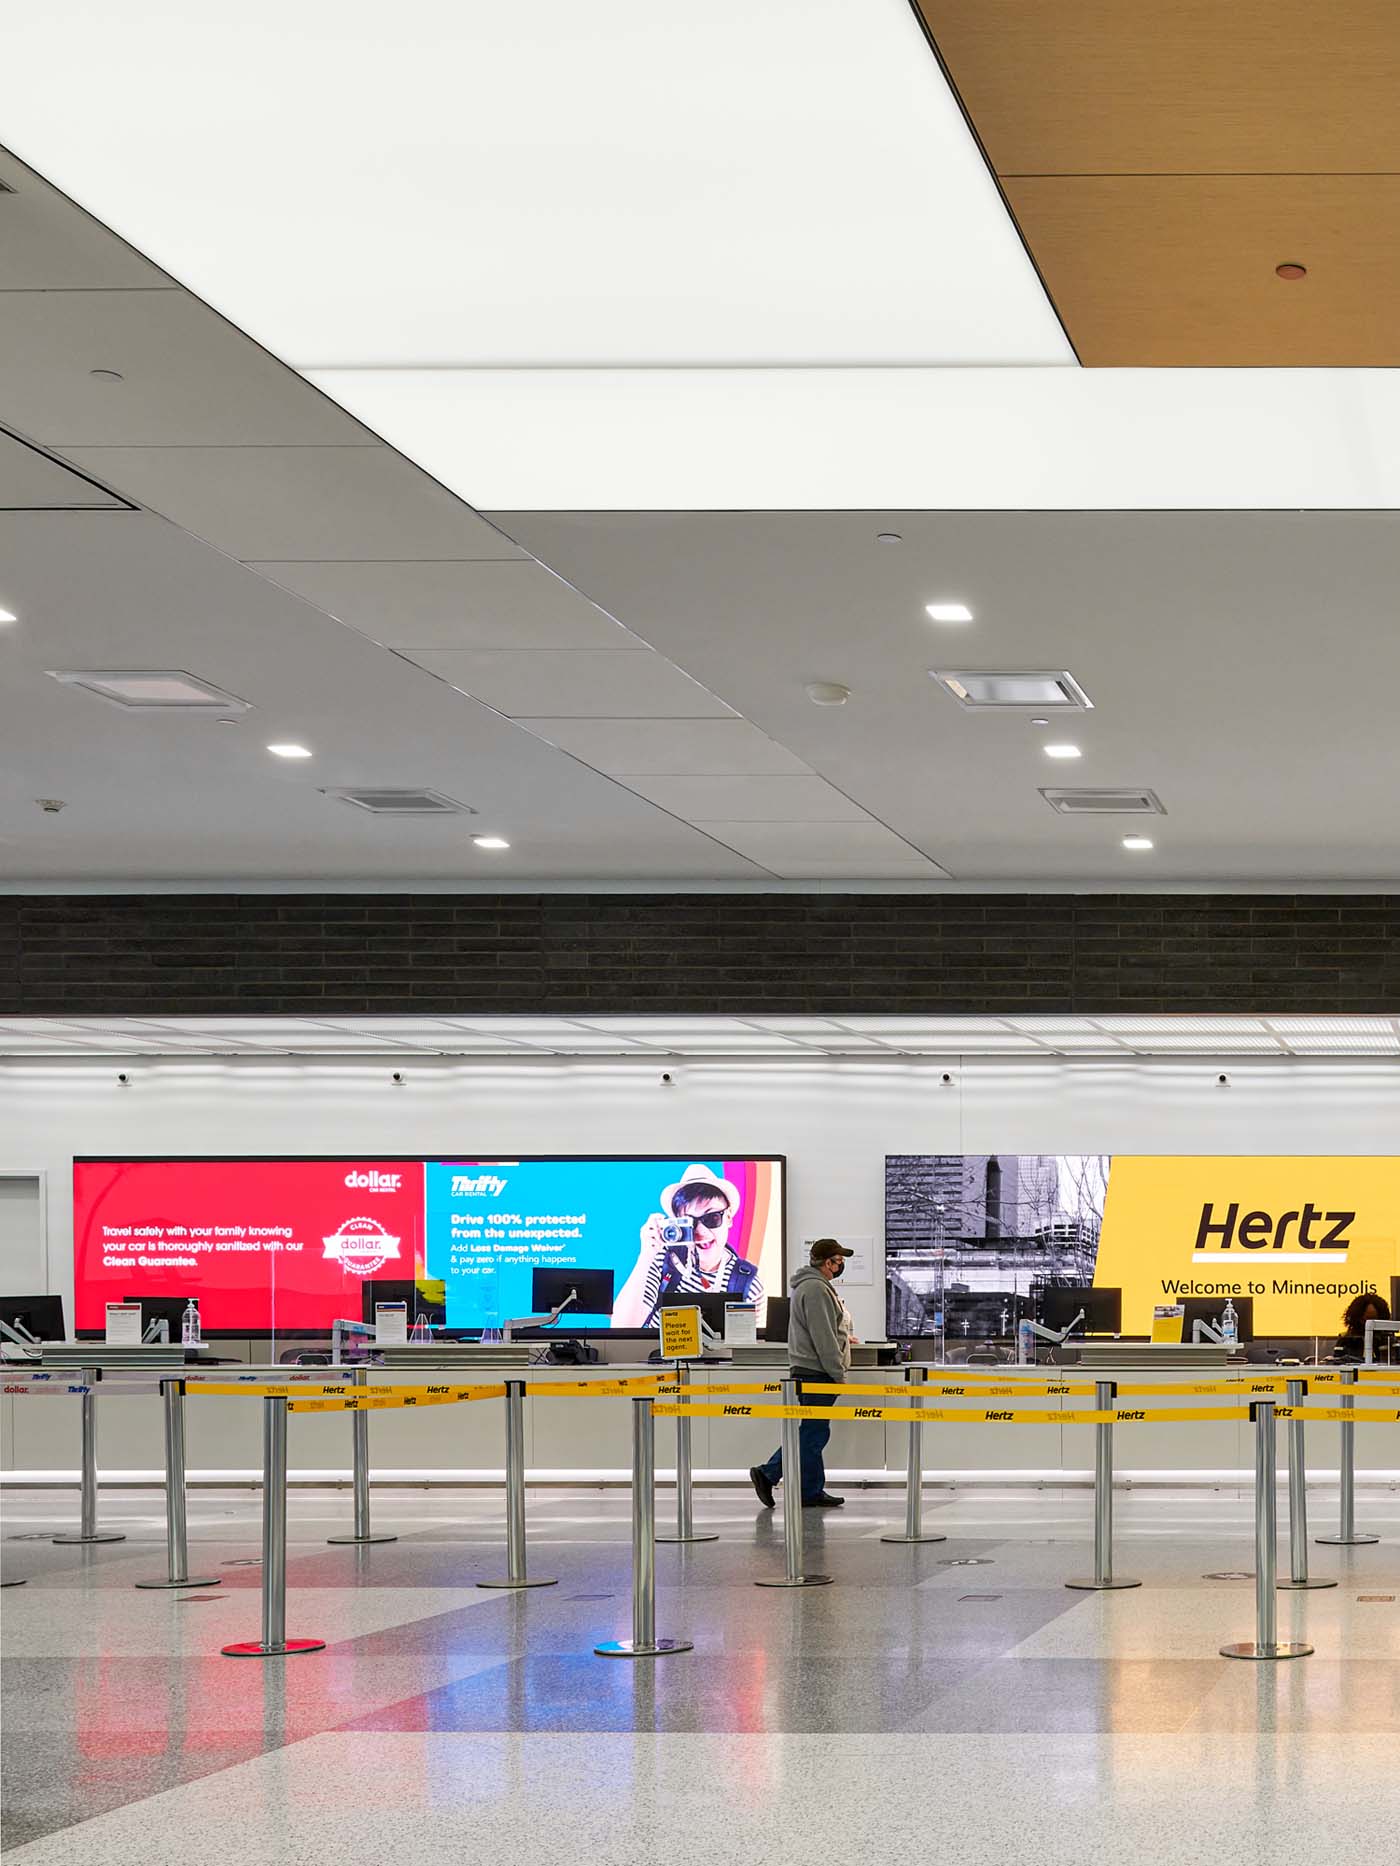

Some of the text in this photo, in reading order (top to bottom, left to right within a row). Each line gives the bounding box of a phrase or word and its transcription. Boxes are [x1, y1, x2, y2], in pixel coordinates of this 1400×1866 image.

[344, 1170, 402, 1188] dollar.
[451, 1175, 508, 1197] Thrifty
[451, 1213, 587, 1227] Drive 100% protected
[1195, 1203, 1356, 1250] Hertz
[102, 1226, 293, 1238] Travel safely with your family knowing
[451, 1227, 583, 1240] from the unexpected.
[102, 1241, 304, 1253] your car is thoroughly sanitized with our
[341, 1238, 381, 1249] dollar.
[451, 1244, 468, 1252] Add
[493, 1244, 529, 1254] Damage
[102, 1256, 199, 1267] Clean Guarantee.
[343, 1256, 381, 1269] UARANTEE
[451, 1255, 457, 1263] &
[460, 1257, 474, 1265] pay
[496, 1255, 502, 1263] if
[504, 1255, 540, 1265] anything
[541, 1255, 577, 1265] happens
[461, 1268, 480, 1276] your
[1161, 1280, 1378, 1298] Welcome to Minneapolis
[1315, 1374, 1334, 1382] Hertz
[323, 1386, 346, 1394] Hertz
[427, 1386, 450, 1394] Hertz
[658, 1385, 681, 1394] Hertz
[763, 1383, 781, 1392] Hert
[941, 1387, 965, 1395] Hertz
[1047, 1386, 1070, 1394] Hertz
[1251, 1384, 1274, 1393] Hertz
[723, 1405, 752, 1415] Hertz
[854, 1408, 882, 1418] Hertz
[1273, 1407, 1293, 1417] ertz
[985, 1411, 1014, 1421] Hertz
[1116, 1410, 1146, 1421] Hertz
